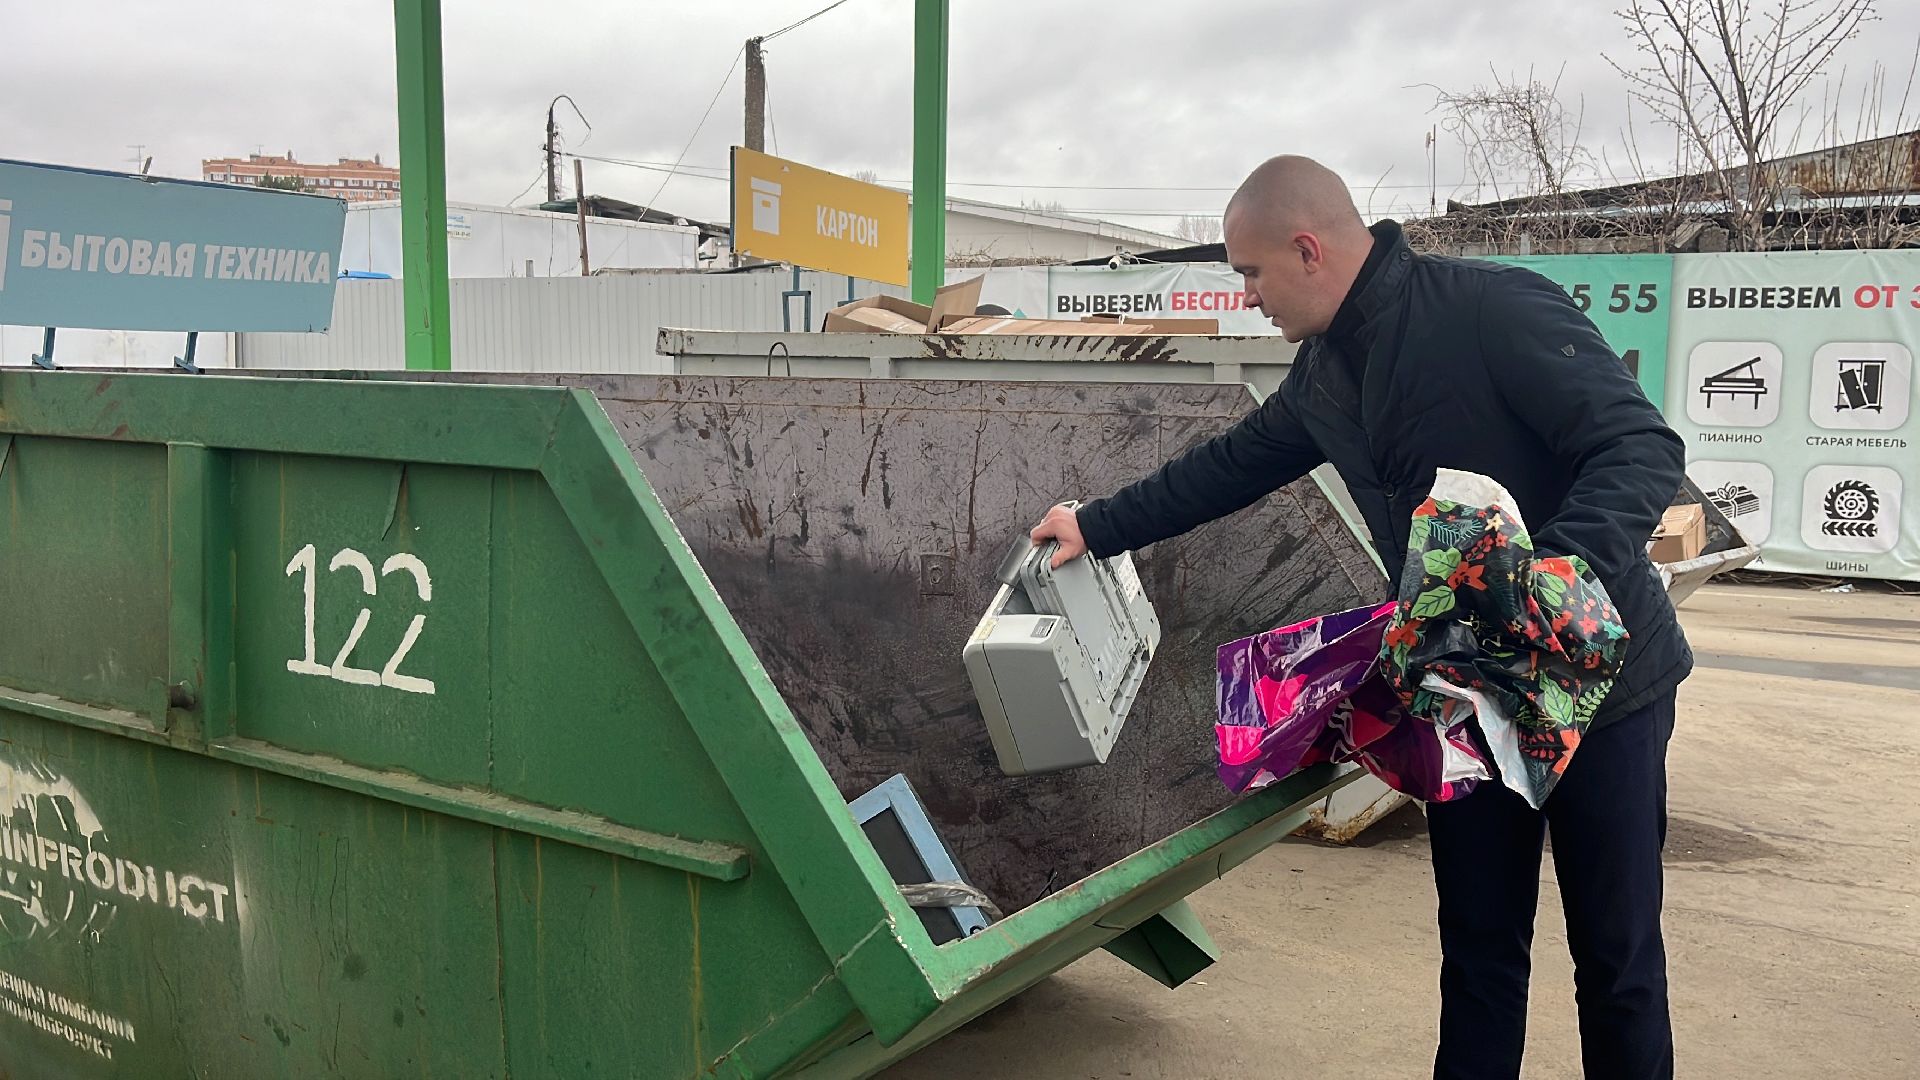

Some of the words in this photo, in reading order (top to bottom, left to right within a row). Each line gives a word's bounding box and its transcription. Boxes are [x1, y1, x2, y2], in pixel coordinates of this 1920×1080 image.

[816, 204, 879, 248] КАРТОН
[20, 229, 197, 278] БЫТОВАЯ
[203, 244, 331, 284] ТЕХНИКА
[1057, 293, 1163, 313] ВЫВЕЗЕМ
[1608, 283, 1658, 314] 55
[1687, 286, 1842, 309] ВЫВЕЗЕМ
[1853, 284, 1900, 309] ОТ
[1698, 432, 1763, 444] ПИАНИНО
[1805, 436, 1853, 447] СТАРАЯ
[1856, 438, 1908, 448] МЕБЕЛЬ
[1825, 561, 1869, 573] ШИНЫ
[286, 543, 435, 694] 122
[0, 827, 229, 923] INPRODUCT
